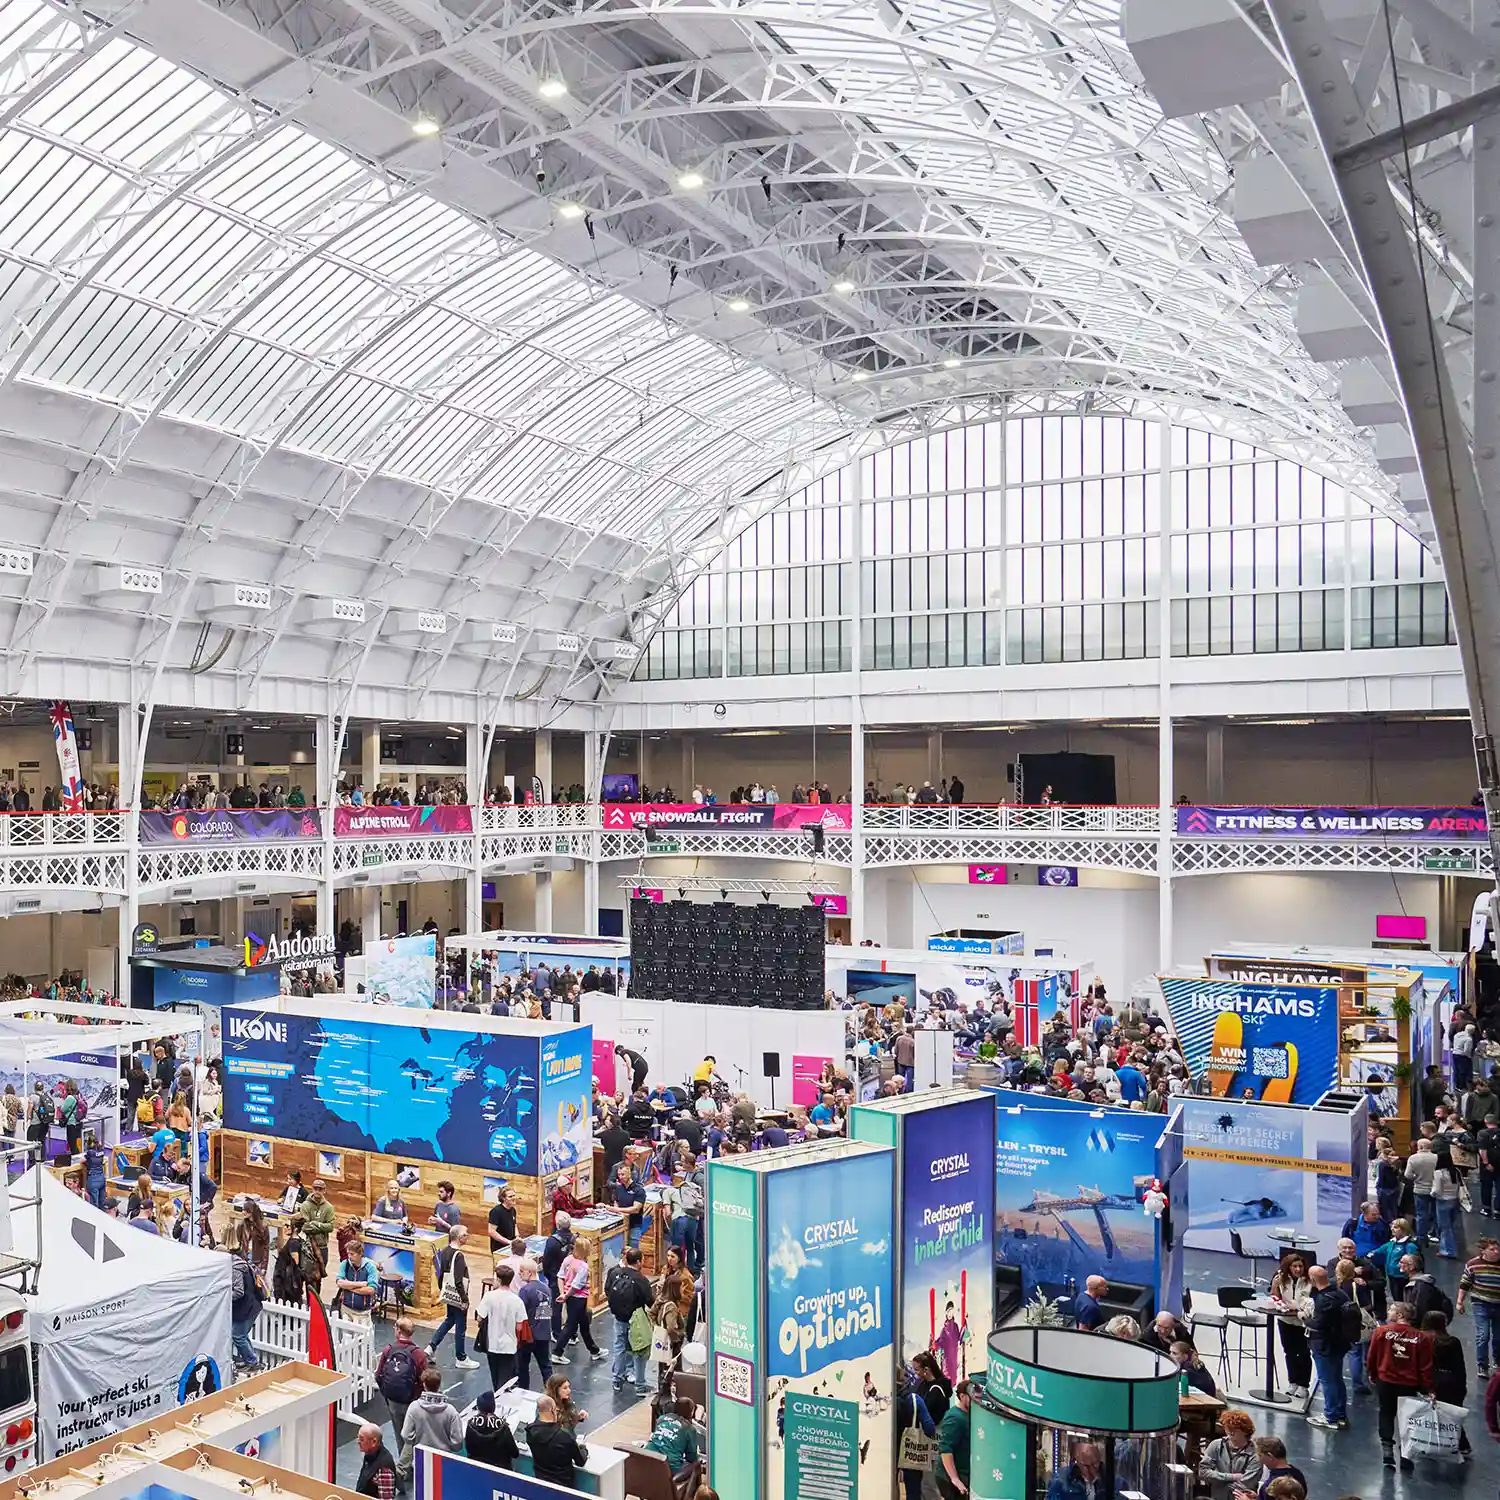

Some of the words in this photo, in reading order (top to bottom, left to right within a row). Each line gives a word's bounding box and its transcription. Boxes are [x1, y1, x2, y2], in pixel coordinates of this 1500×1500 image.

[350, 816, 381, 829] ALPINE
[380, 815, 411, 828] STROLL
[630, 812, 646, 822] VR
[648, 812, 718, 823] SNOWBALL
[721, 812, 764, 823] FIGHT
[1215, 816, 1298, 830] FITNESS
[1300, 816, 1316, 830] &
[1318, 816, 1424, 831] WELLNESS
[190, 822, 234, 833] COLORADO
[264, 929, 337, 962] Andorra
[280, 954, 337, 972] visitandorra.com
[1191, 991, 1315, 1017] INGHAMS
[1242, 1015, 1263, 1024] SKI
[229, 1017, 281, 1042] IKON
[1213, 1057, 1247, 1065] HOLIDAY
[1219, 1046, 1247, 1058] WIN
[1227, 1137, 1280, 1150] PYRENEES
[1256, 1127, 1295, 1141] SECRET
[1028, 1143, 1068, 1157] TRYSIL
[930, 1152, 970, 1176] CRYSTAL
[712, 1200, 754, 1219] CRYSTAL
[923, 1200, 974, 1225] Rediscover
[804, 1216, 859, 1245] CRYSTAL
[938, 1217, 962, 1240] your
[914, 1236, 949, 1267] inner
[951, 1213, 983, 1252] child
[794, 1288, 846, 1315] Growing
[848, 1285, 867, 1302] up,
[65, 1307, 98, 1325] MAISON
[101, 1299, 126, 1314] SPORT
[721, 1325, 739, 1338] WIN
[740, 1331, 748, 1341] A
[779, 1285, 891, 1374] Optional
[714, 1331, 755, 1352] HOLIDAY
[57, 1399, 87, 1418] Your
[87, 1384, 130, 1414] perfect
[132, 1374, 149, 1393] ski
[57, 1408, 114, 1440] instructor
[116, 1403, 127, 1418] is
[127, 1396, 151, 1418] just
[153, 1392, 161, 1404] a
[793, 1402, 851, 1421] CRYSTAL
[797, 1425, 844, 1440] SNOWBALL
